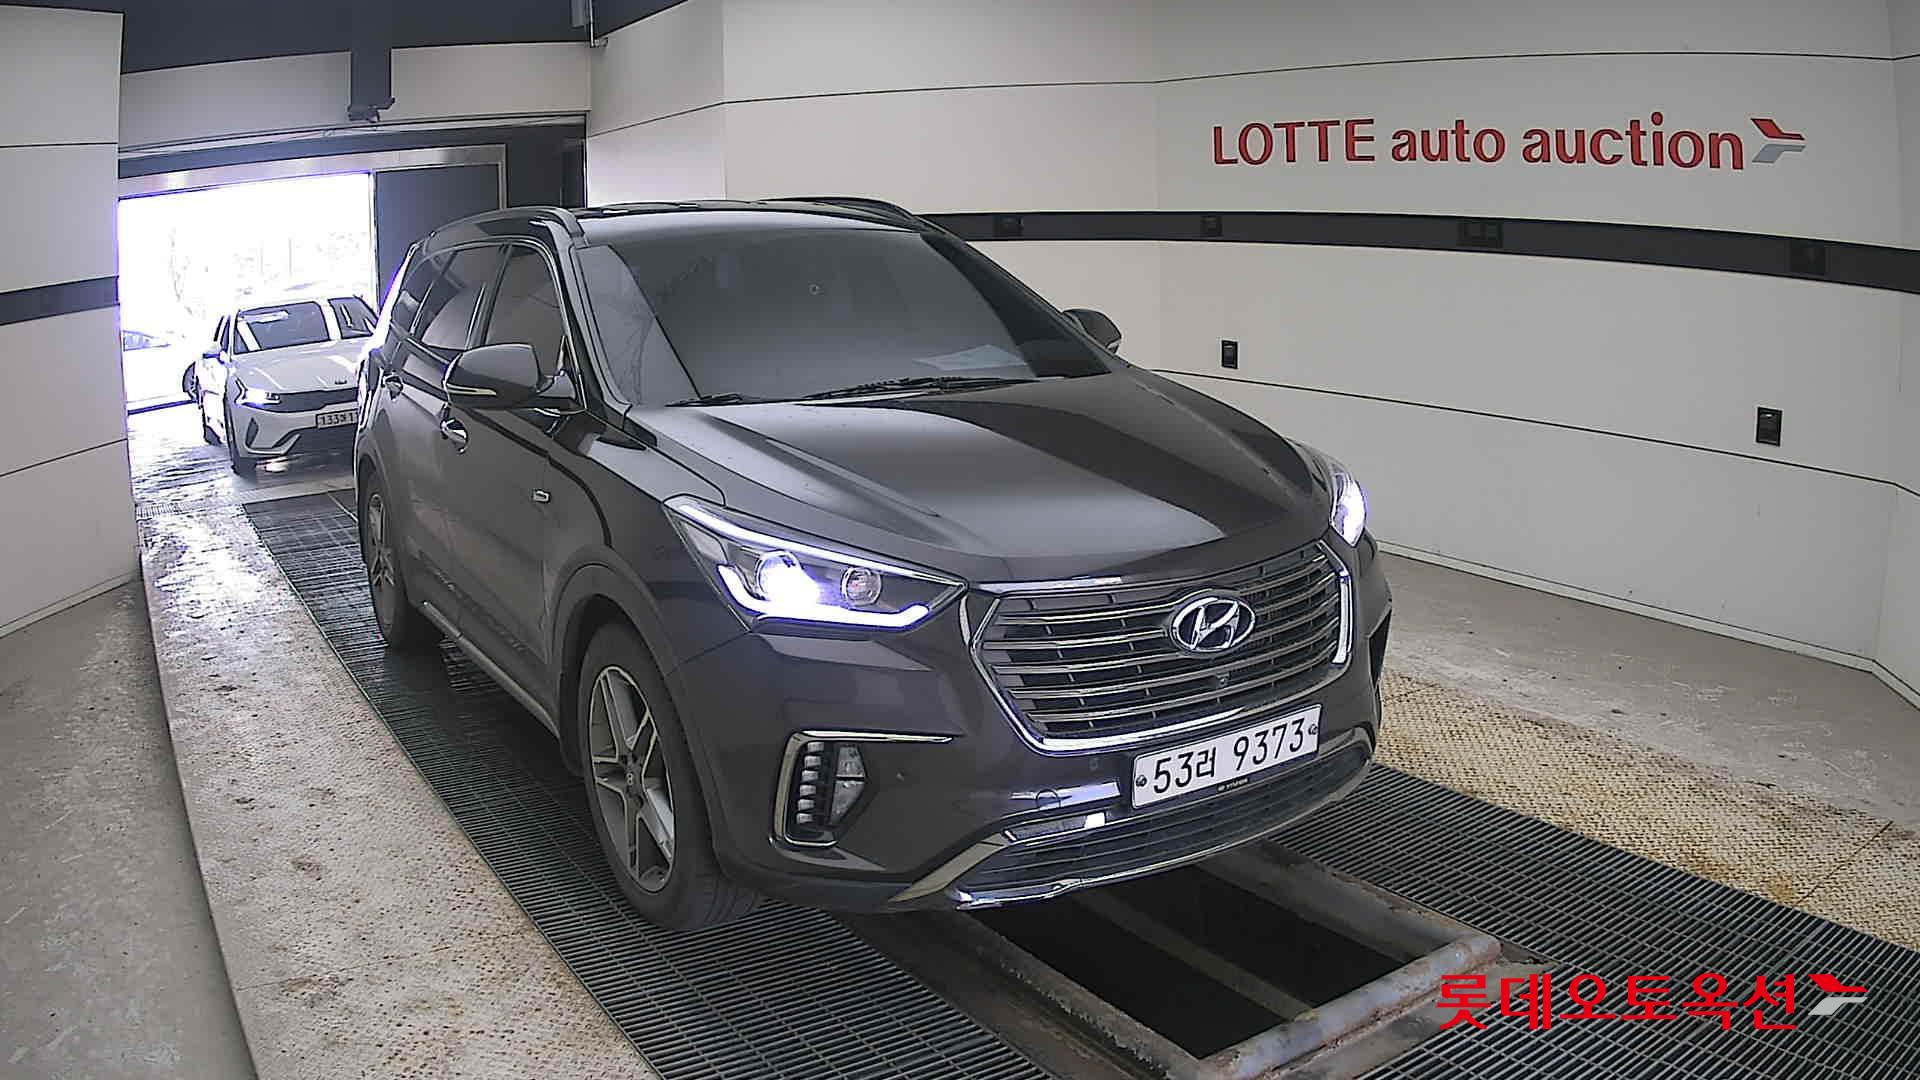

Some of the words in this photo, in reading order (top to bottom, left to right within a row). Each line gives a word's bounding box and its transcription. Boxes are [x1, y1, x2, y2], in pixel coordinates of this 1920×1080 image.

[1213, 119, 1375, 165] LOTTE
[1391, 119, 1506, 163] auto
[1522, 111, 1745, 170] auction
[1153, 746, 1217, 794] 53러
[1232, 717, 1305, 771] 9373
